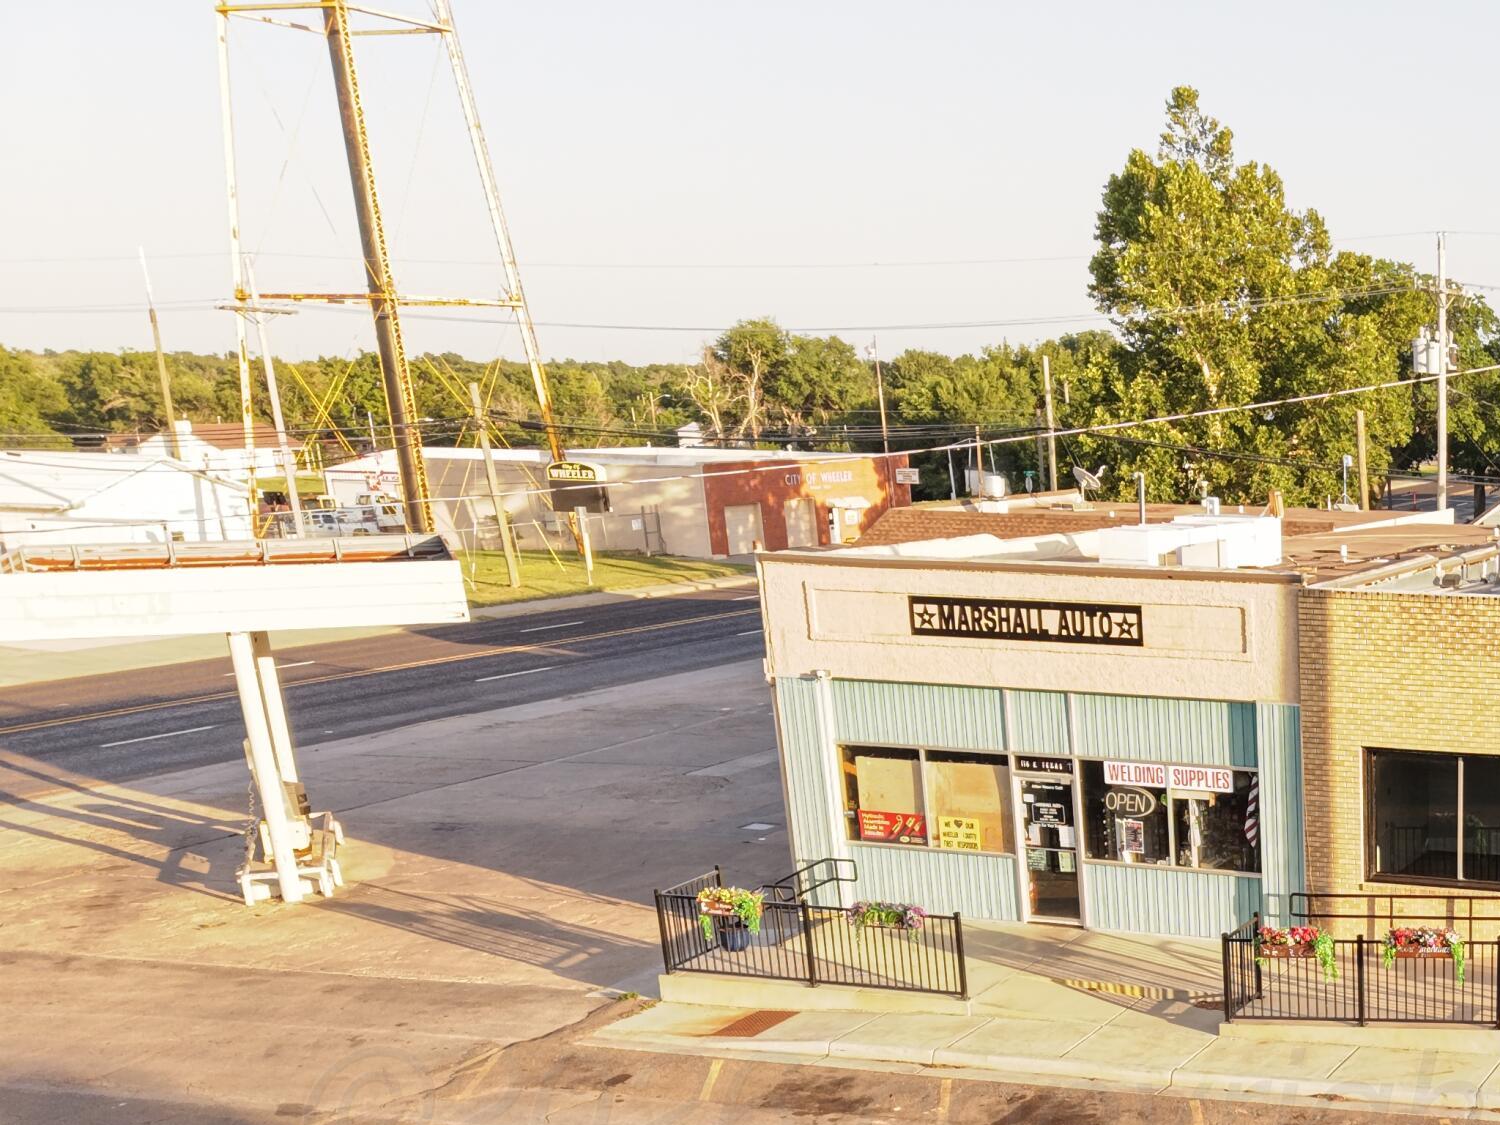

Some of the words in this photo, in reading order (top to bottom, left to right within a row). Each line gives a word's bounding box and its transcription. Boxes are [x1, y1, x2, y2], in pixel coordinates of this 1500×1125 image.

[549, 469, 595, 480] WHEELER
[784, 473, 801, 486] CITY
[805, 472, 817, 485] OF
[819, 470, 852, 484] WHEELER
[937, 602, 1049, 636] MARSHALL
[1057, 609, 1114, 639] AUTO
[1108, 763, 1164, 785] WELDING
[1173, 768, 1230, 790] SUPPLIES
[1105, 791, 1147, 813] OPEN
